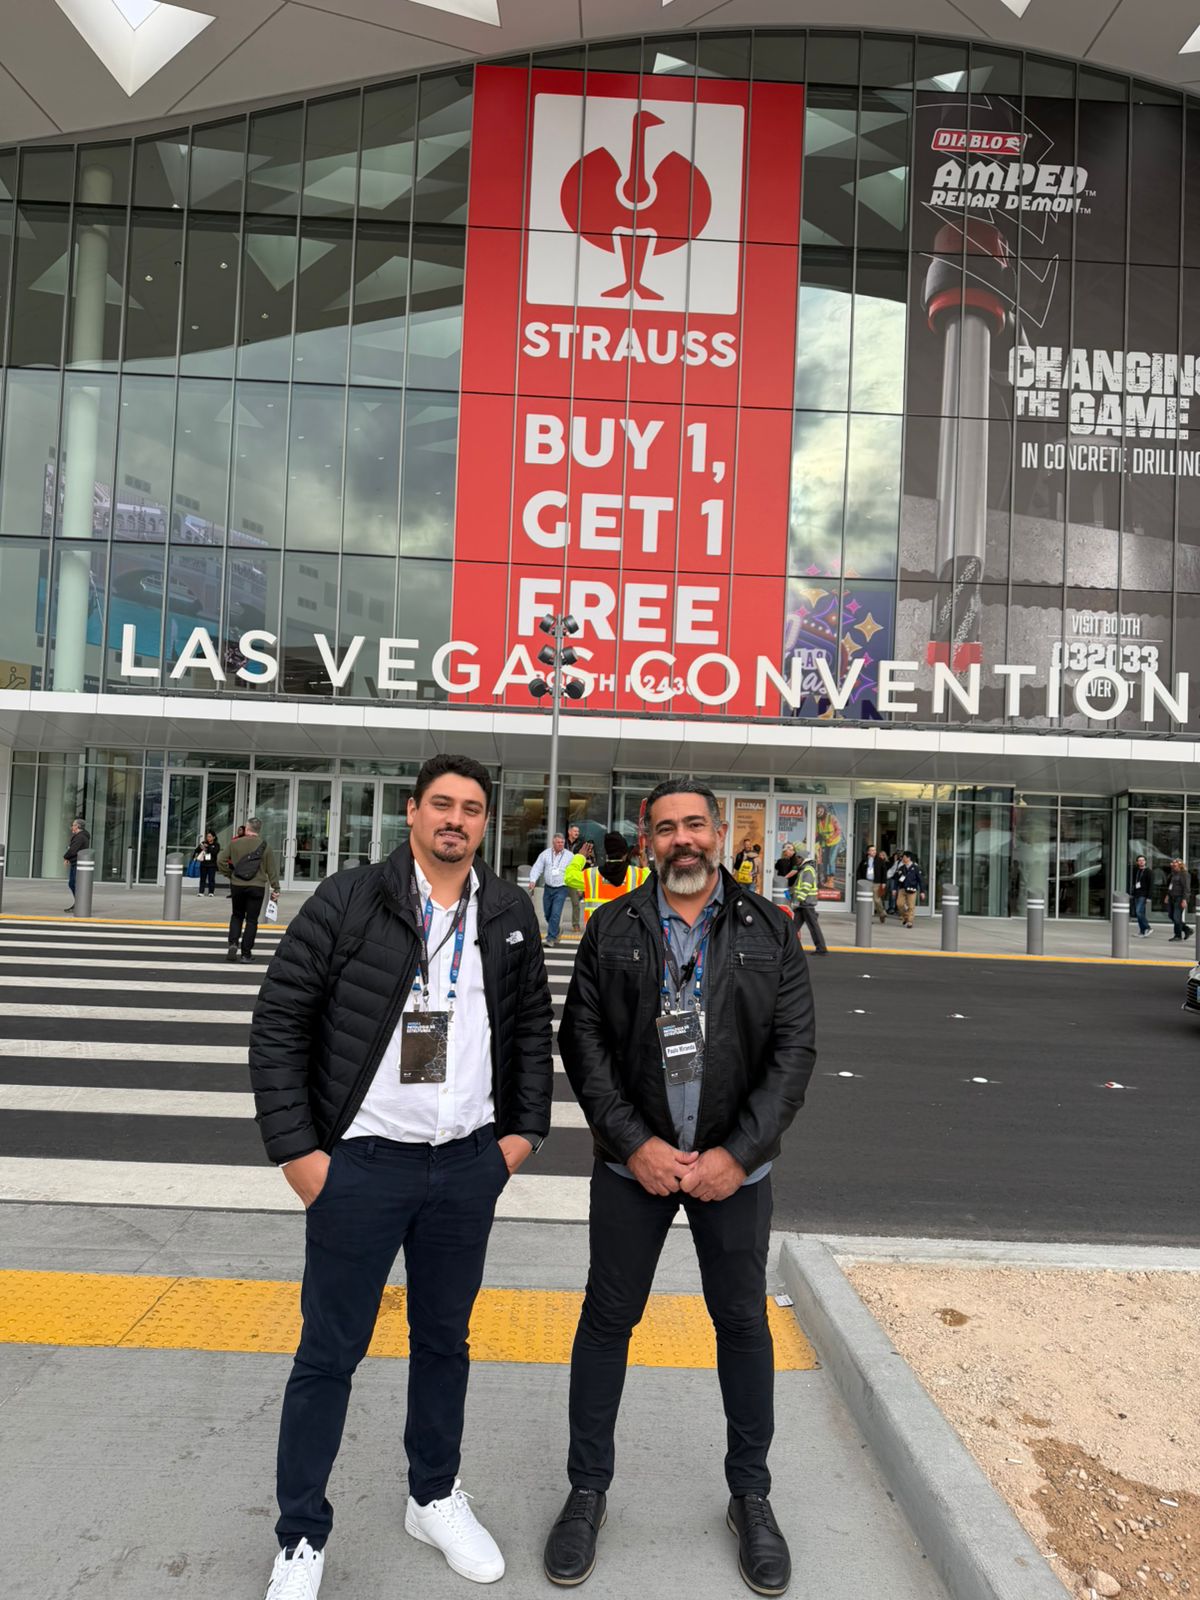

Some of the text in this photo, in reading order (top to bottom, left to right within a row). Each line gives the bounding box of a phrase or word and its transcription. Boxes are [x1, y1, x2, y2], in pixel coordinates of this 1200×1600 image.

[938, 132, 1000, 149] DIABLO
[932, 159, 1088, 195] AMPED
[930, 190, 1000, 209] REBAR
[1005, 194, 1081, 213] DEMON
[523, 321, 737, 368] STRAUSS
[1008, 345, 1200, 397] CHANGIN
[1016, 390, 1060, 418] THE
[1070, 391, 1190, 440] GAME
[524, 413, 726, 484] BUY 1,
[1021, 442, 1038, 469] IN
[1044, 443, 1127, 473] CONCRETE
[522, 490, 724, 556] GET 1
[518, 577, 720, 645] FREE
[1072, 615, 1140, 636] VISIT BOOTH
[120, 623, 1190, 724] LAS VEGAS CONVENTION
[1052, 642, 1159, 673] 032033
[780, 805, 803, 815] MAX
